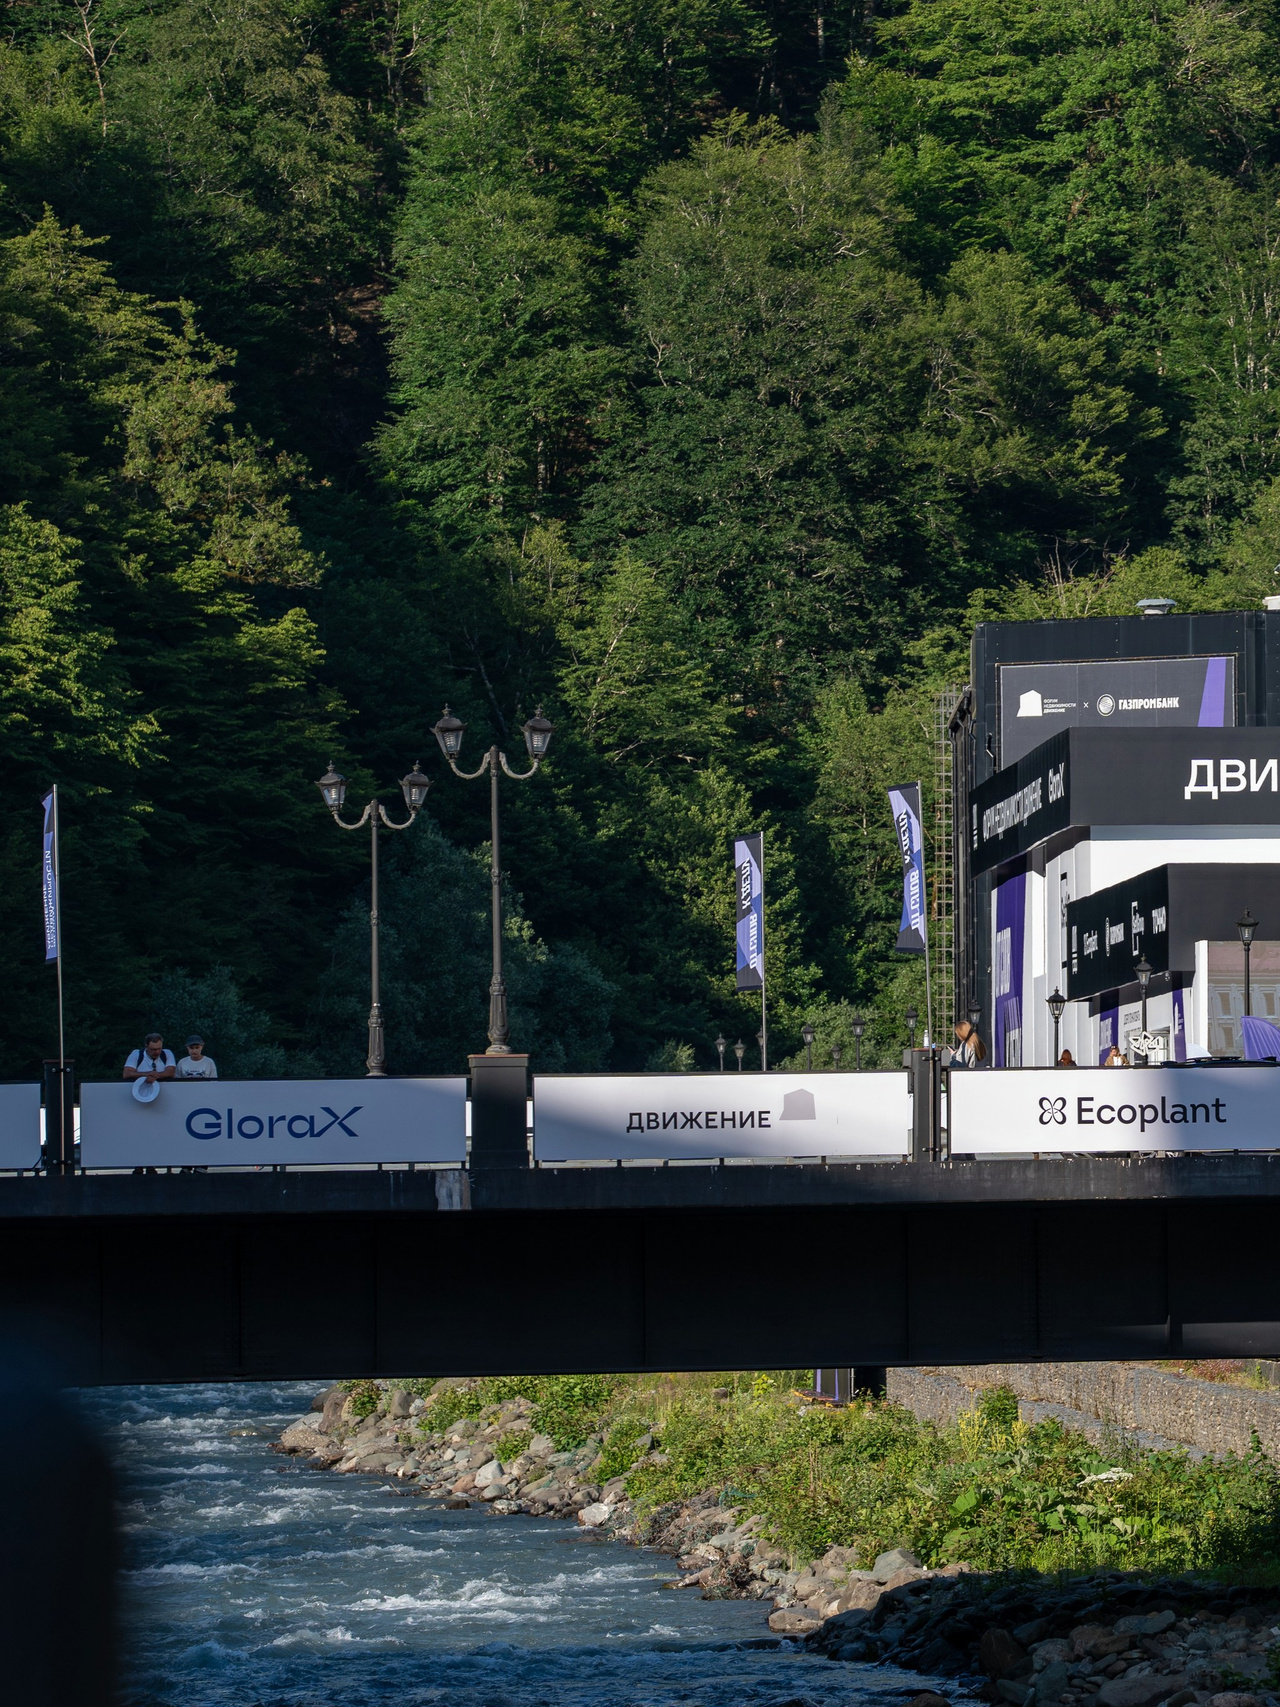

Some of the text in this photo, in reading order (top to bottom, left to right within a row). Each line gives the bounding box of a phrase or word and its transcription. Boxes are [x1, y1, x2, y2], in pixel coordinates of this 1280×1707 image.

[1118, 697, 1179, 710] ГАЗПРОМБАНК
[186, 1106, 363, 1140] GloraX
[626, 1110, 771, 1134] ДВИЖЕНИЕ
[1077, 1096, 1227, 1133] Ecoplant
